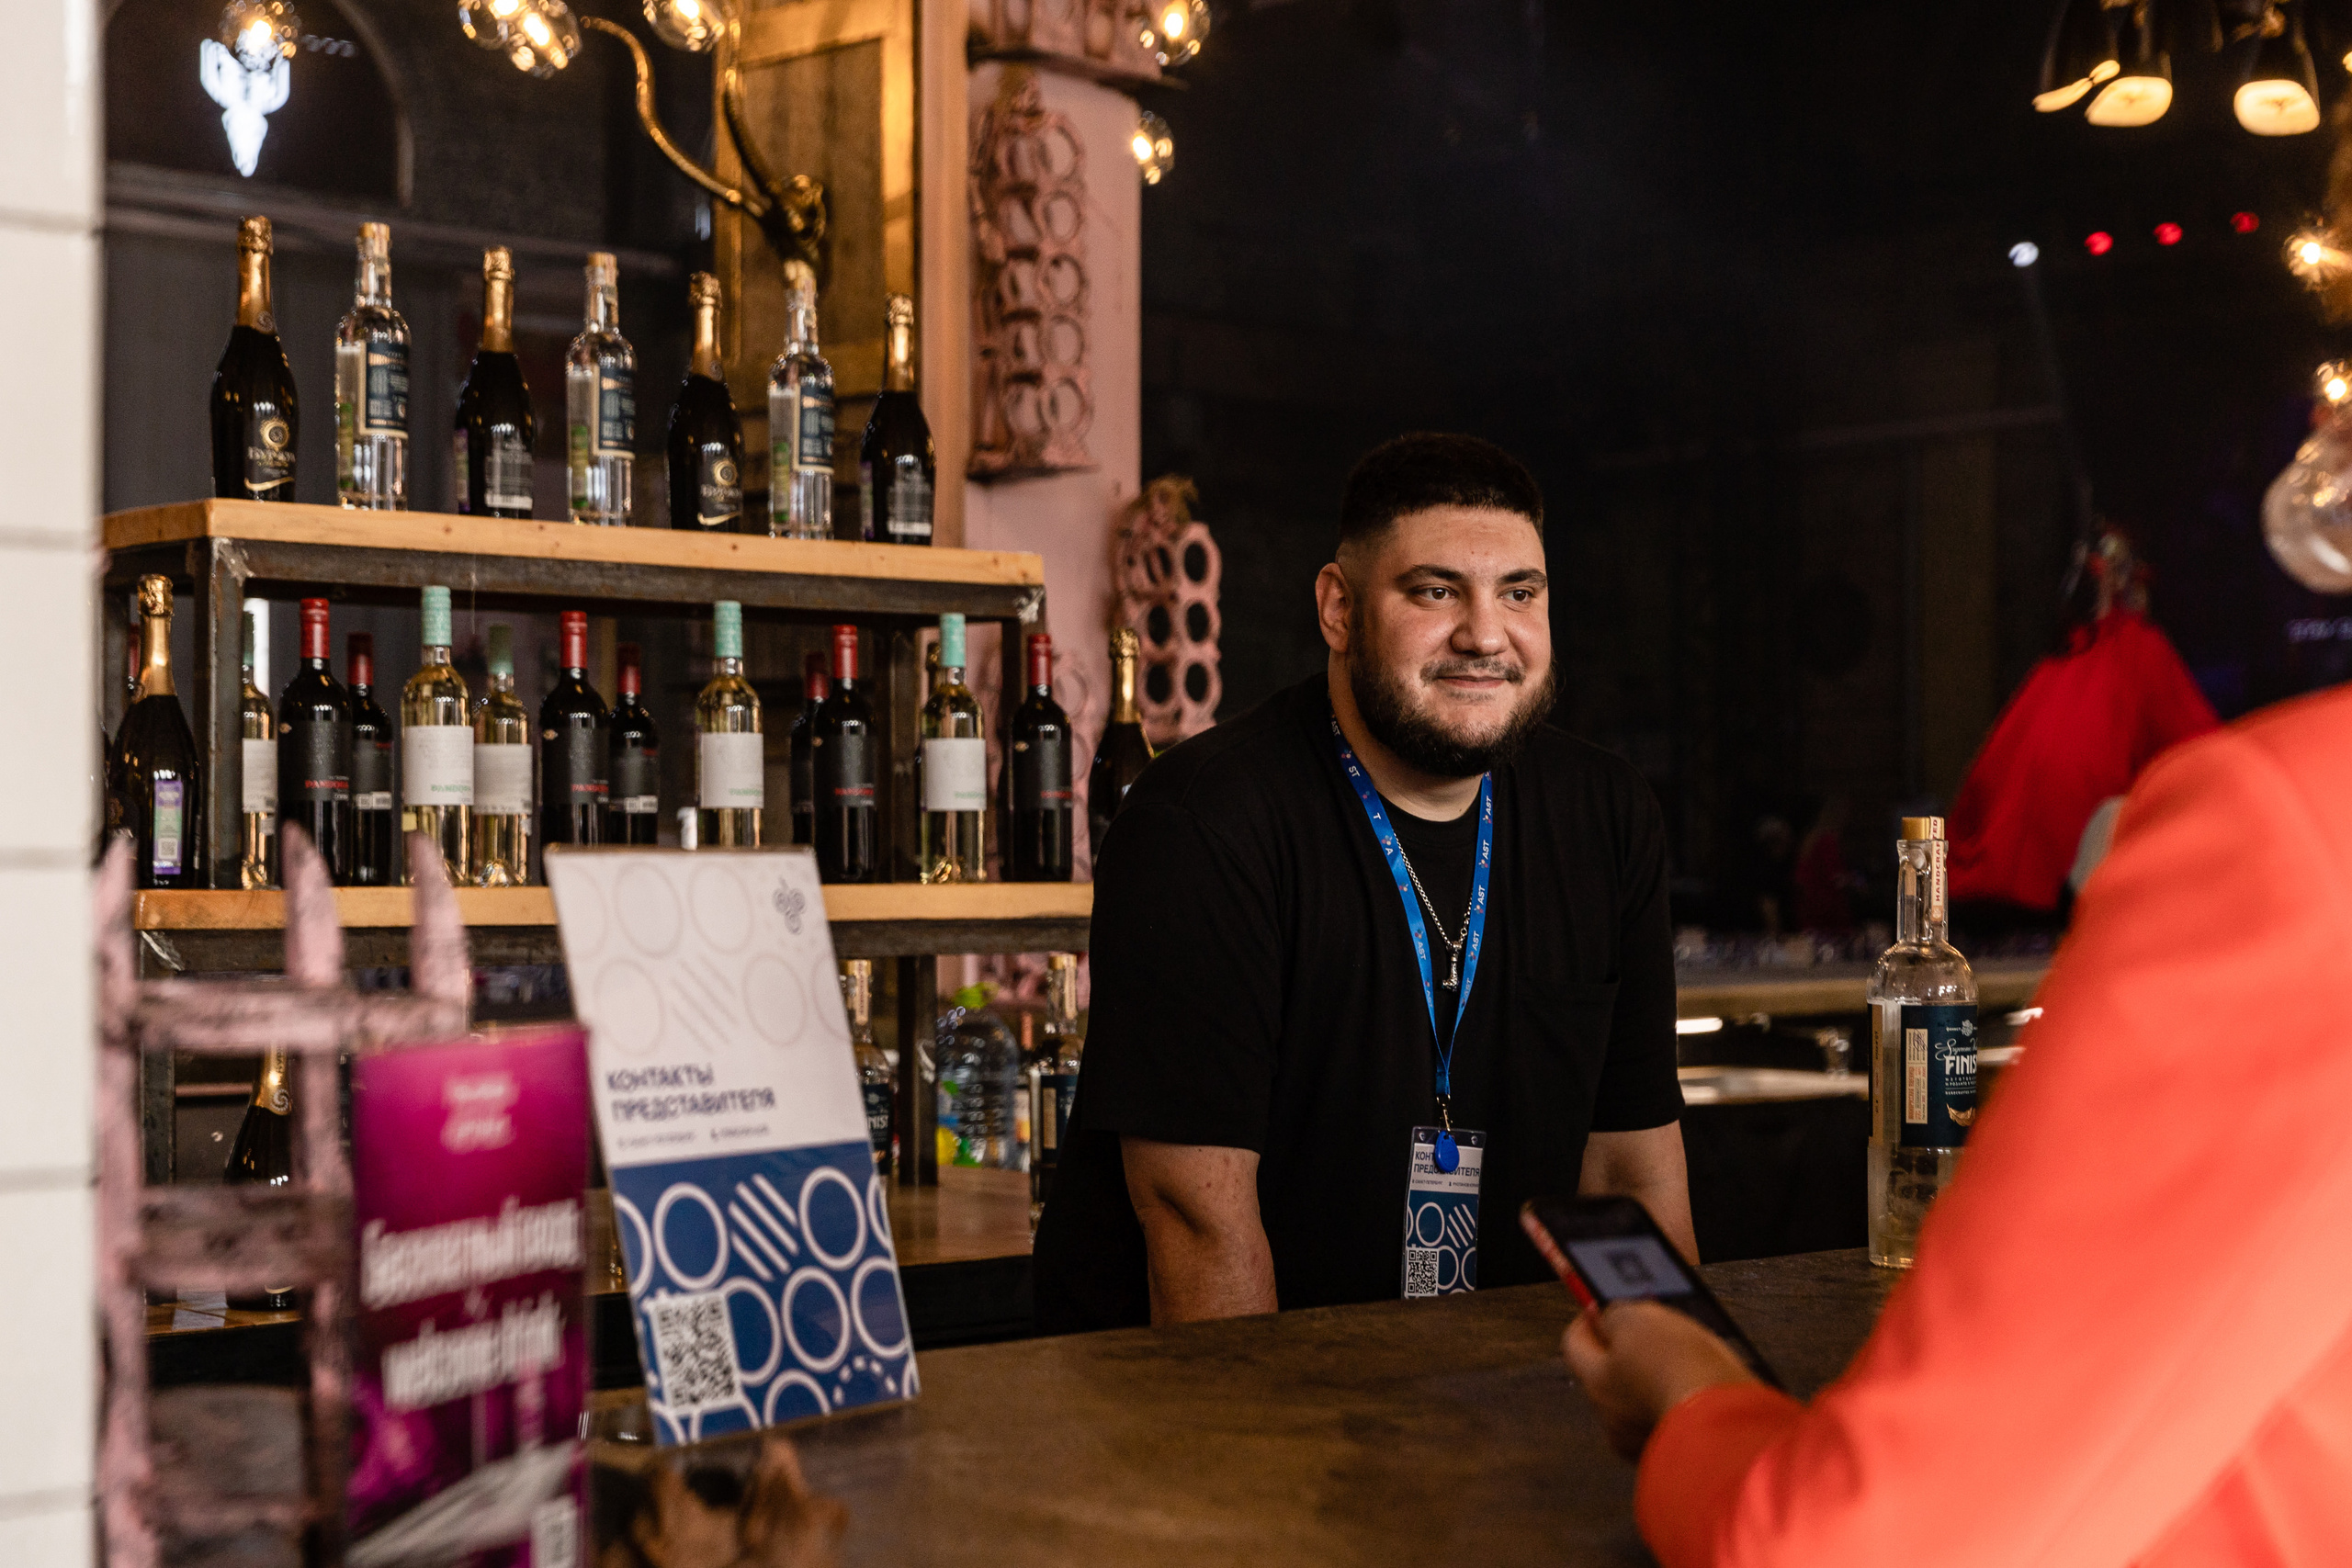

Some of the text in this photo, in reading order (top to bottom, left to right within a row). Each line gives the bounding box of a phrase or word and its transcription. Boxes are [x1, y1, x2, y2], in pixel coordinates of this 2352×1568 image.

[1485, 795, 1493, 817] AST
[1482, 840, 1490, 861] AST
[1932, 818, 1941, 902] HANDCRAFTED
[1477, 885, 1486, 906] AST
[1417, 942, 1427, 961] AST
[1472, 931, 1481, 952] AST
[1464, 977, 1472, 998] AST
[607, 1063, 714, 1091] КОНТАКТЫ
[611, 1087, 775, 1122] ПРЕДСТАВИТЕЛЯ
